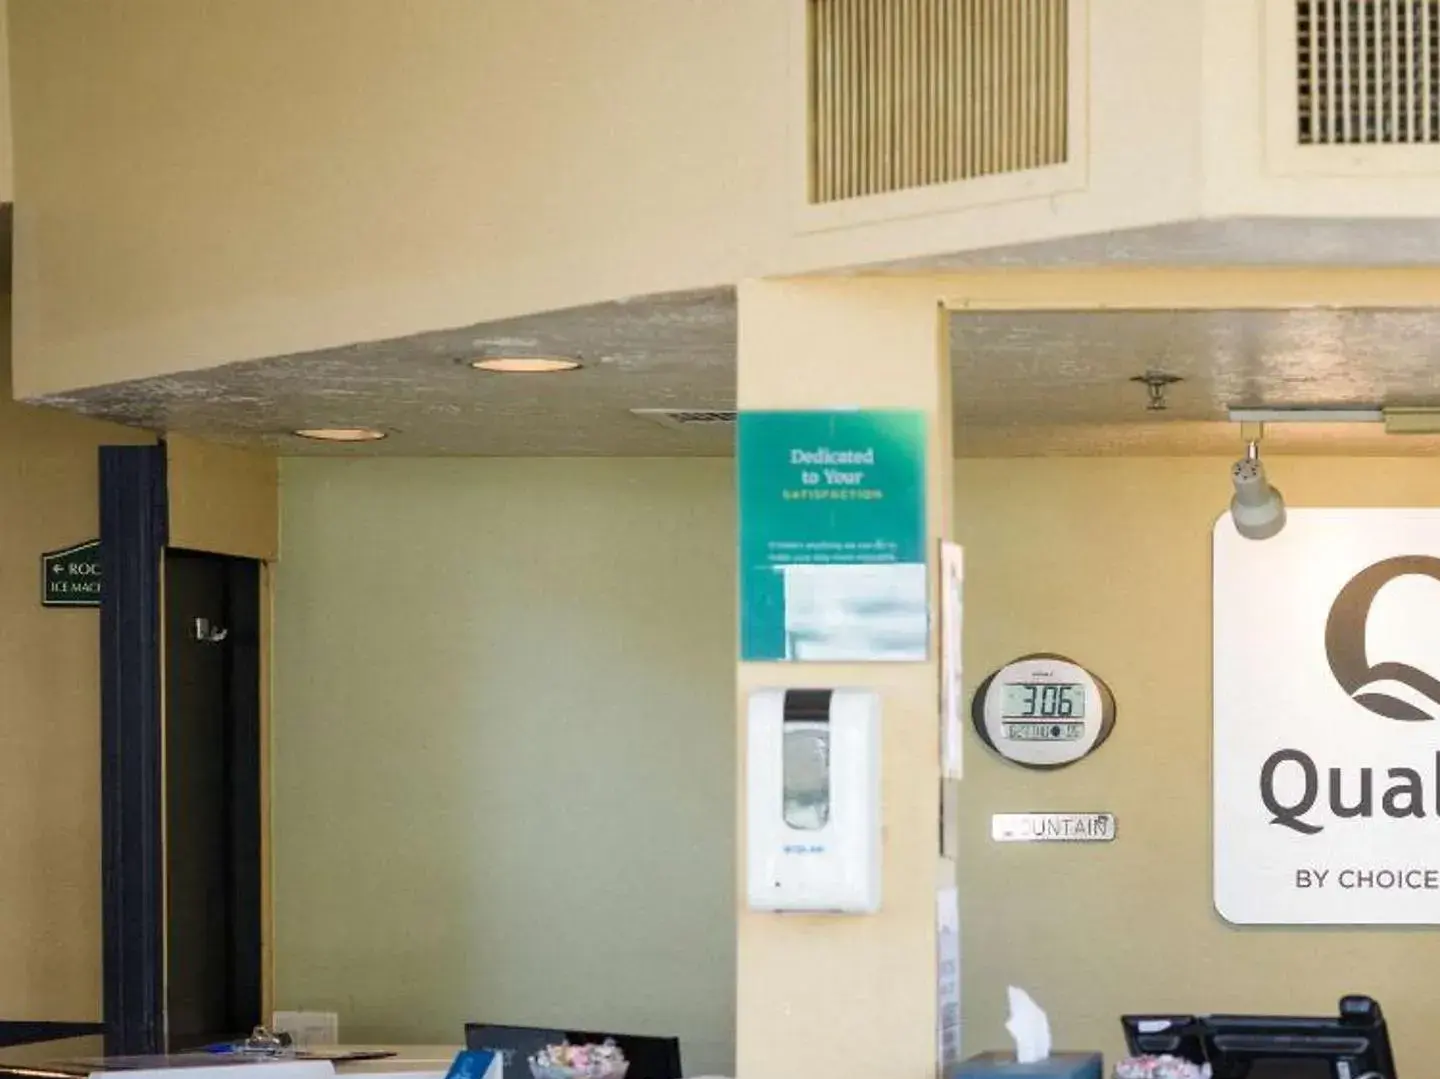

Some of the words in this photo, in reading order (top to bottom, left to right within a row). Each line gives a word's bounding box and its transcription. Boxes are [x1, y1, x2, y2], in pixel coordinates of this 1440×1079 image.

[789, 447, 875, 465] Dedicated
[801, 470, 820, 485] to
[823, 469, 865, 485] Your
[1022, 817, 1108, 837] UNTAIN
[1296, 869, 1329, 889] BY
[1338, 869, 1440, 889] CHOICE
